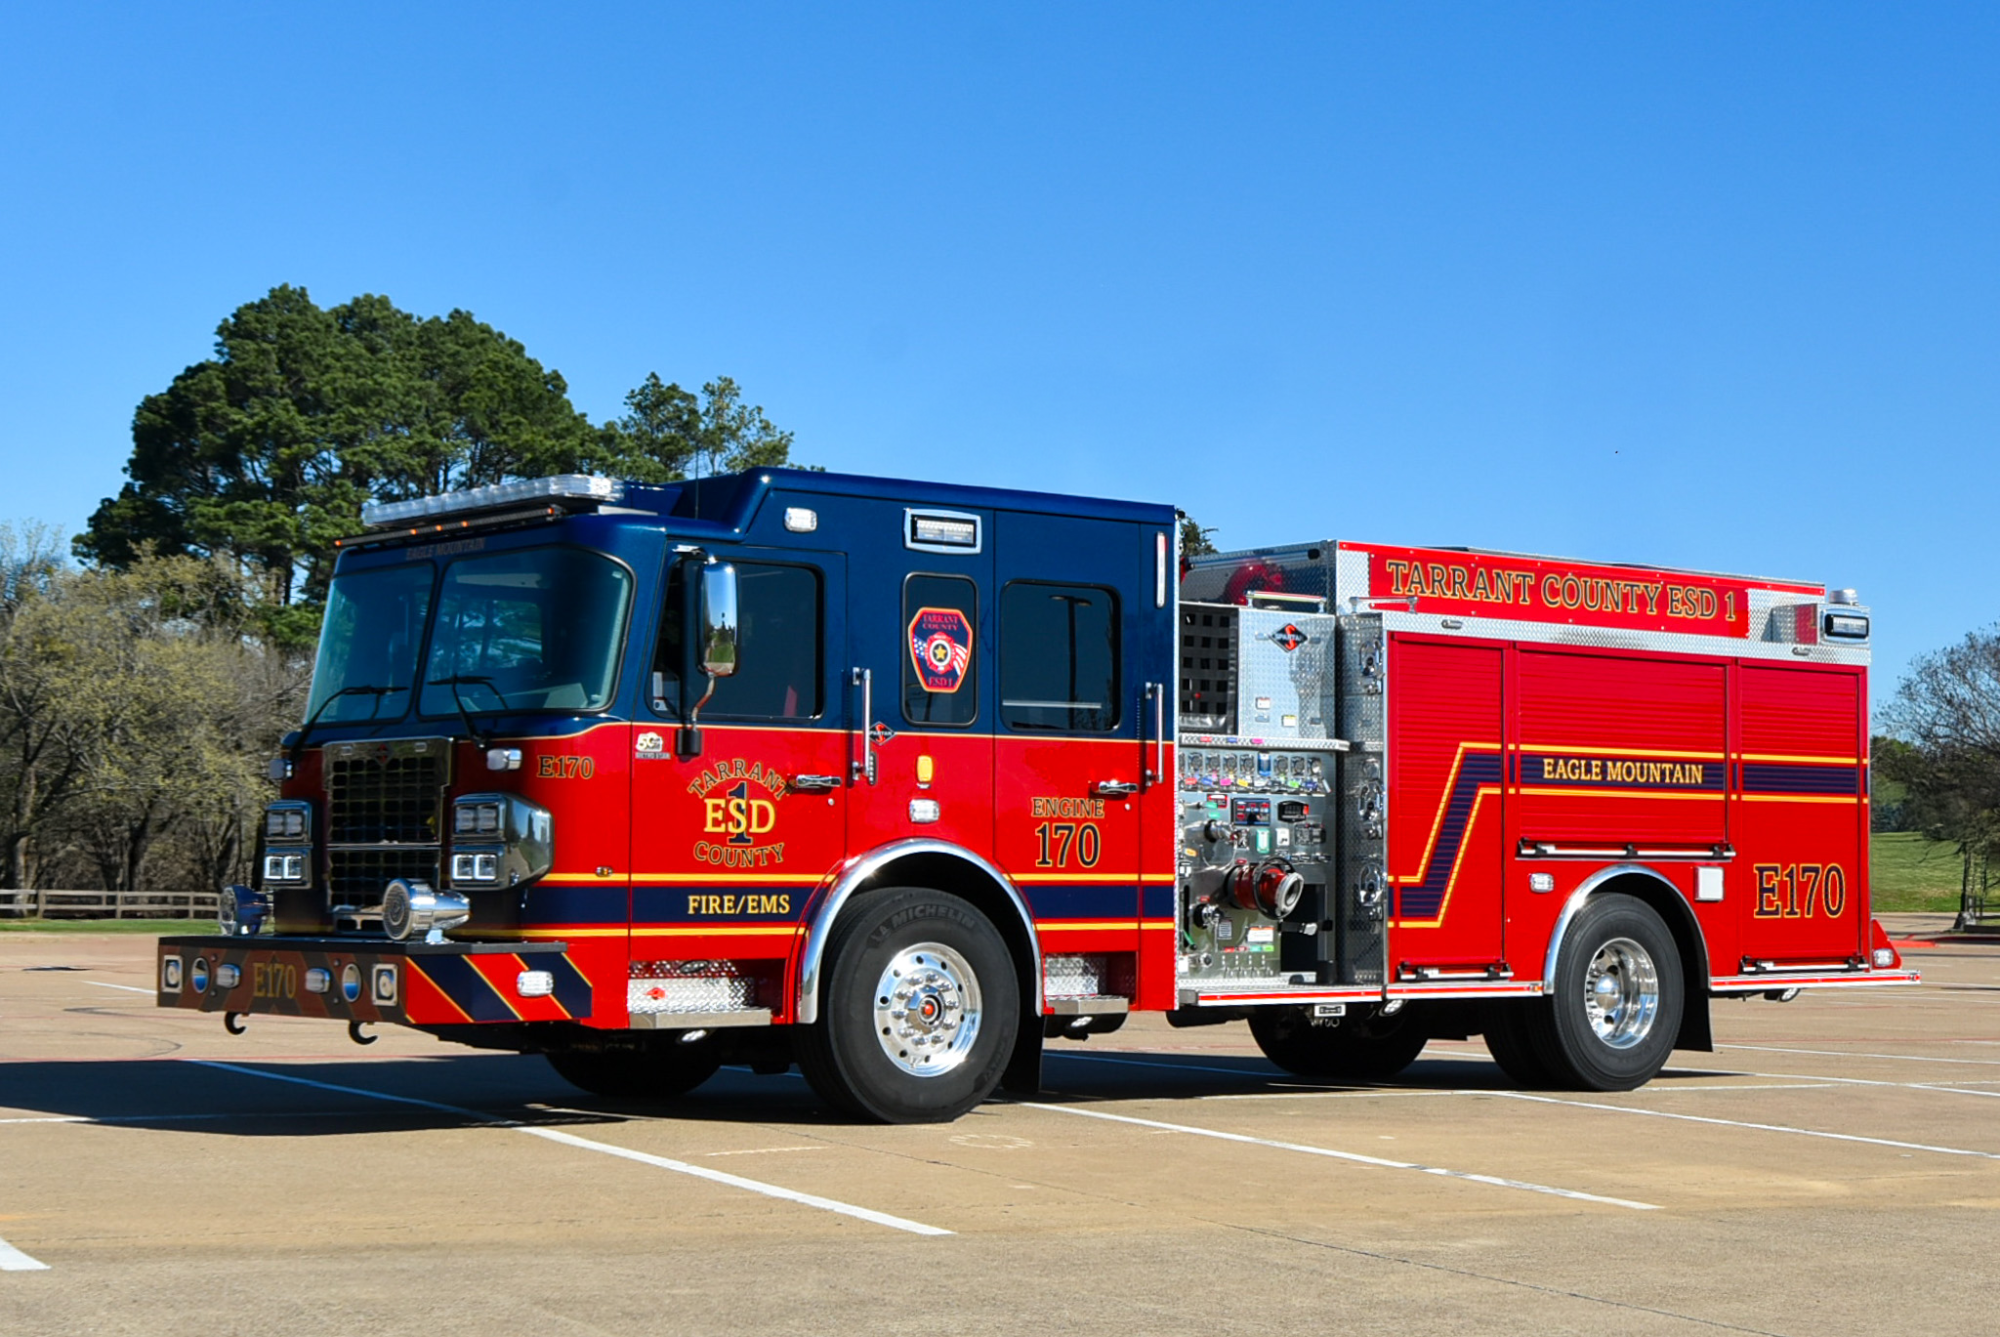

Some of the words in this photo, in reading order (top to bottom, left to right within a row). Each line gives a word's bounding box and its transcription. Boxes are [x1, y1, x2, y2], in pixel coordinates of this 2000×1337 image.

[1386, 559, 1535, 605] TARRANT
[1541, 574, 1661, 614] COUNTY
[1667, 586, 1718, 619] ESD
[1725, 592, 1736, 621] 1
[537, 755, 595, 779] E170
[687, 758, 793, 801] TARRANT
[1543, 758, 1602, 781] EAGLE
[1606, 761, 1703, 784] MOUNTAIN
[703, 798, 776, 834] ESD
[1031, 797, 1105, 819] ENGINE
[693, 840, 785, 868] COUNTY
[1035, 821, 1101, 868] 170
[687, 894, 791, 915] FIRE/EMS
[1753, 863, 1846, 919] E170
[891, 905, 975, 929] MICHELIN
[253, 962, 297, 999] E170
